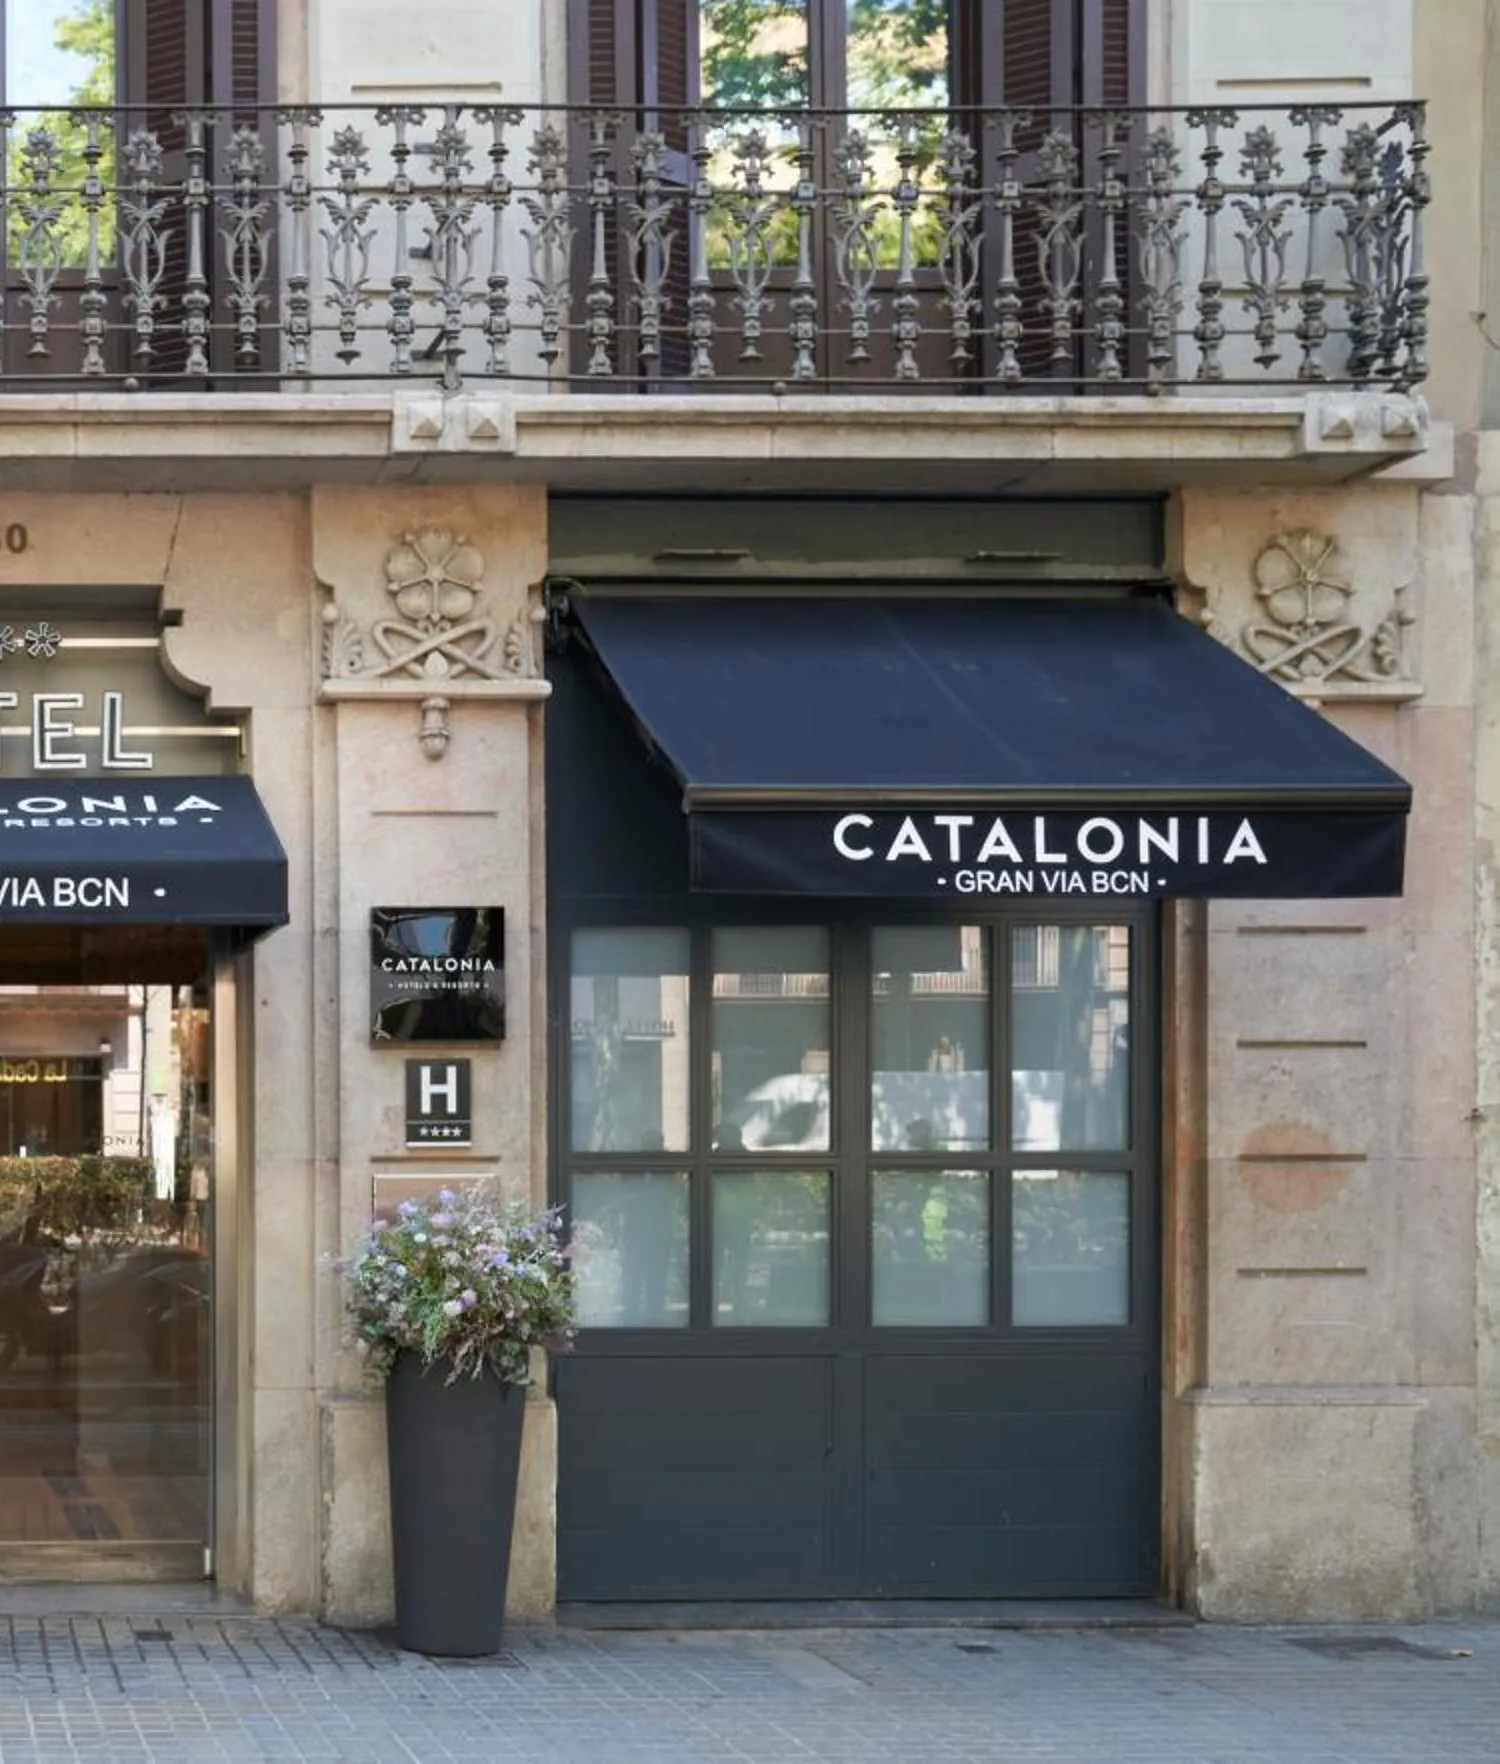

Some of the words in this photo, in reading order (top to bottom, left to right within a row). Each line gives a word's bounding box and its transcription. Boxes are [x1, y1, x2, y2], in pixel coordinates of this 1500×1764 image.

[833, 813, 1268, 865] CATALONIA
[52, 877, 130, 907] BCN
[955, 869, 1034, 893] GRAN
[1042, 870, 1087, 893] VIA
[1092, 870, 1150, 893] BCN
[381, 957, 496, 973] CATALONIA
[420, 1065, 457, 1115] H
